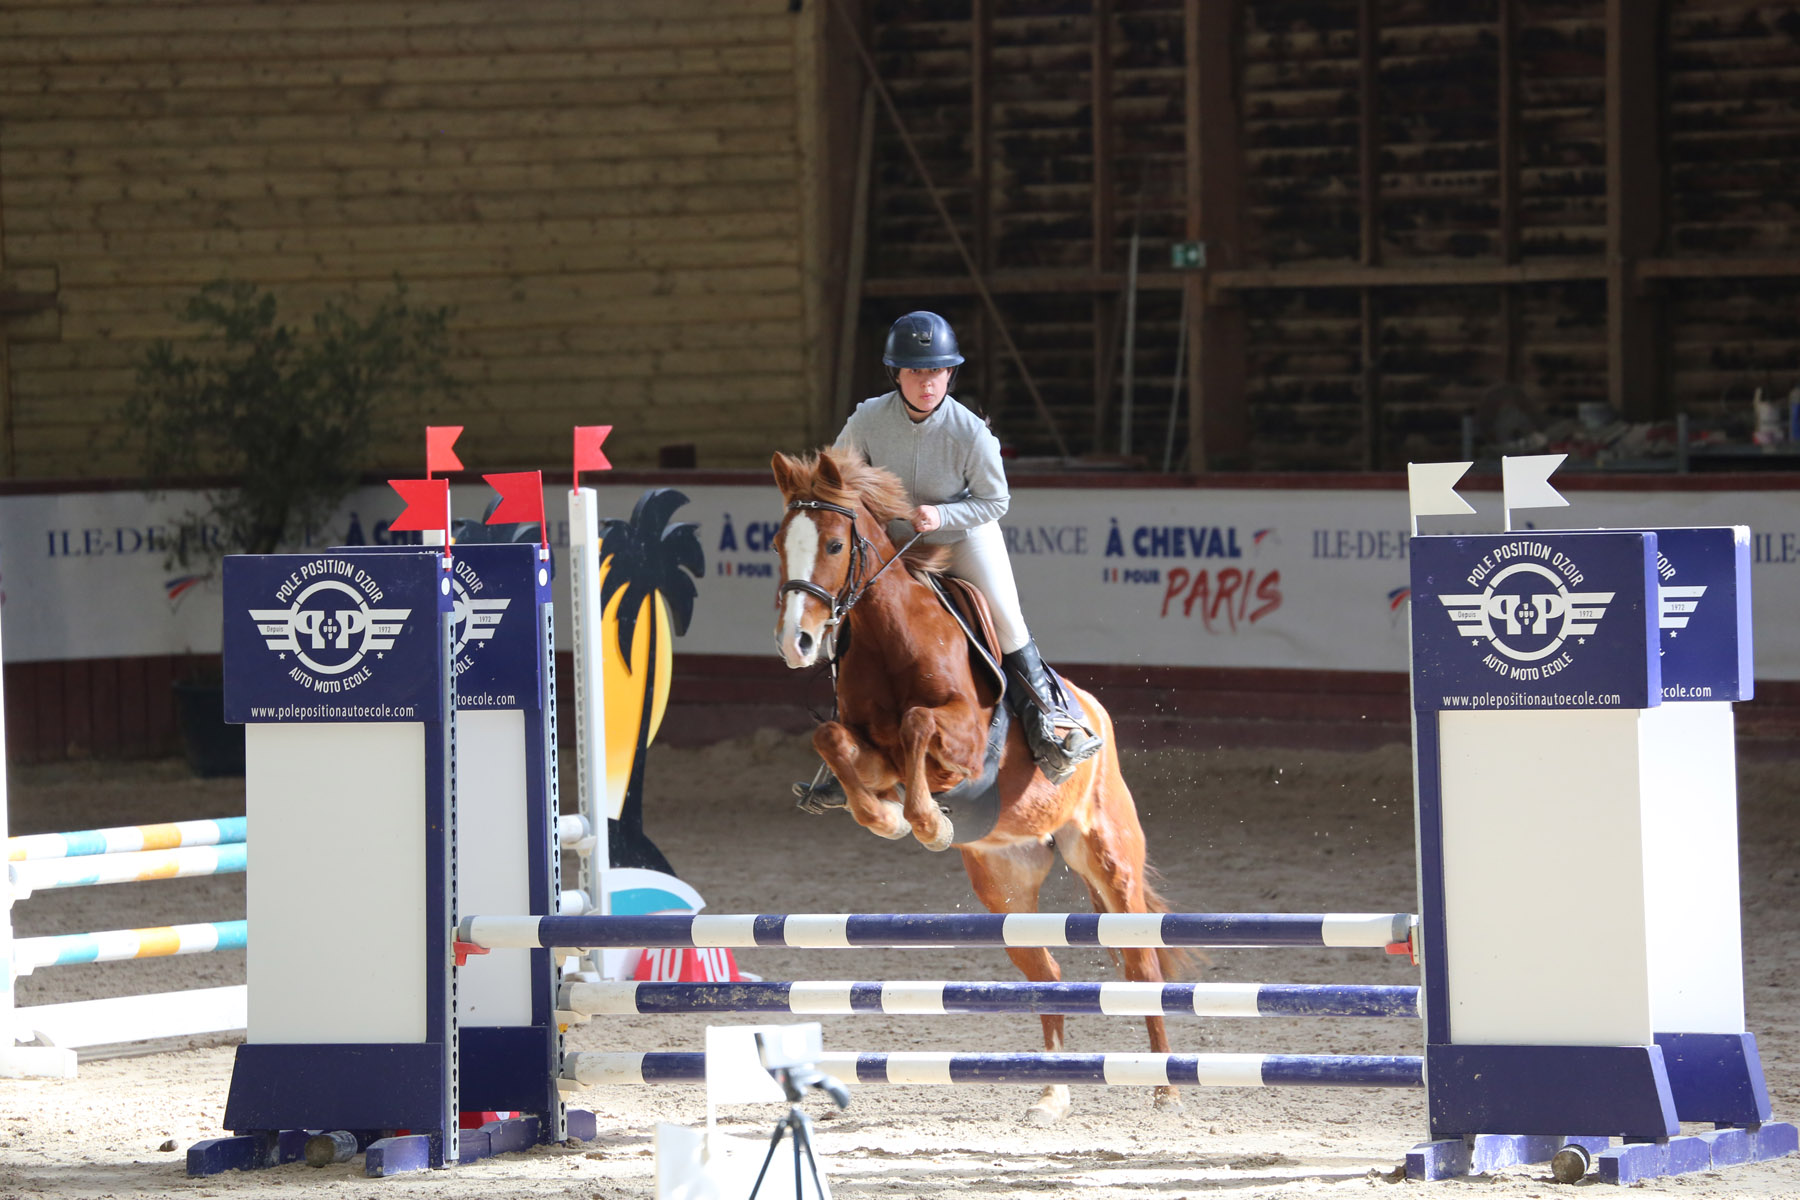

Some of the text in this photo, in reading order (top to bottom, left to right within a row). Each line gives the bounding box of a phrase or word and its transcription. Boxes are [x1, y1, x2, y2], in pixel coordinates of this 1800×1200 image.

[719, 511, 738, 552] À
[1105, 516, 1243, 559] À CHEVAL
[455, 561, 484, 594] OZOIR
[1123, 568, 1160, 584] POUR
[1467, 541, 1585, 588] POLE POSITION OZOIR
[275, 559, 384, 604] POLE POSITION OZOIR
[1160, 566, 1283, 636] PARIS
[1457, 610, 1477, 619] Depuis
[1579, 610, 1593, 618] 1972
[266, 625, 284, 634] Depuis
[378, 626, 391, 634] 1972
[288, 665, 373, 693] AUTO MOTO ECOLE
[1482, 651, 1574, 681] AUTO MOTO ECOLE
[250, 704, 415, 720] www.polepositionautoecole.com
[1442, 691, 1621, 709] www.polepositionautoecole.com
